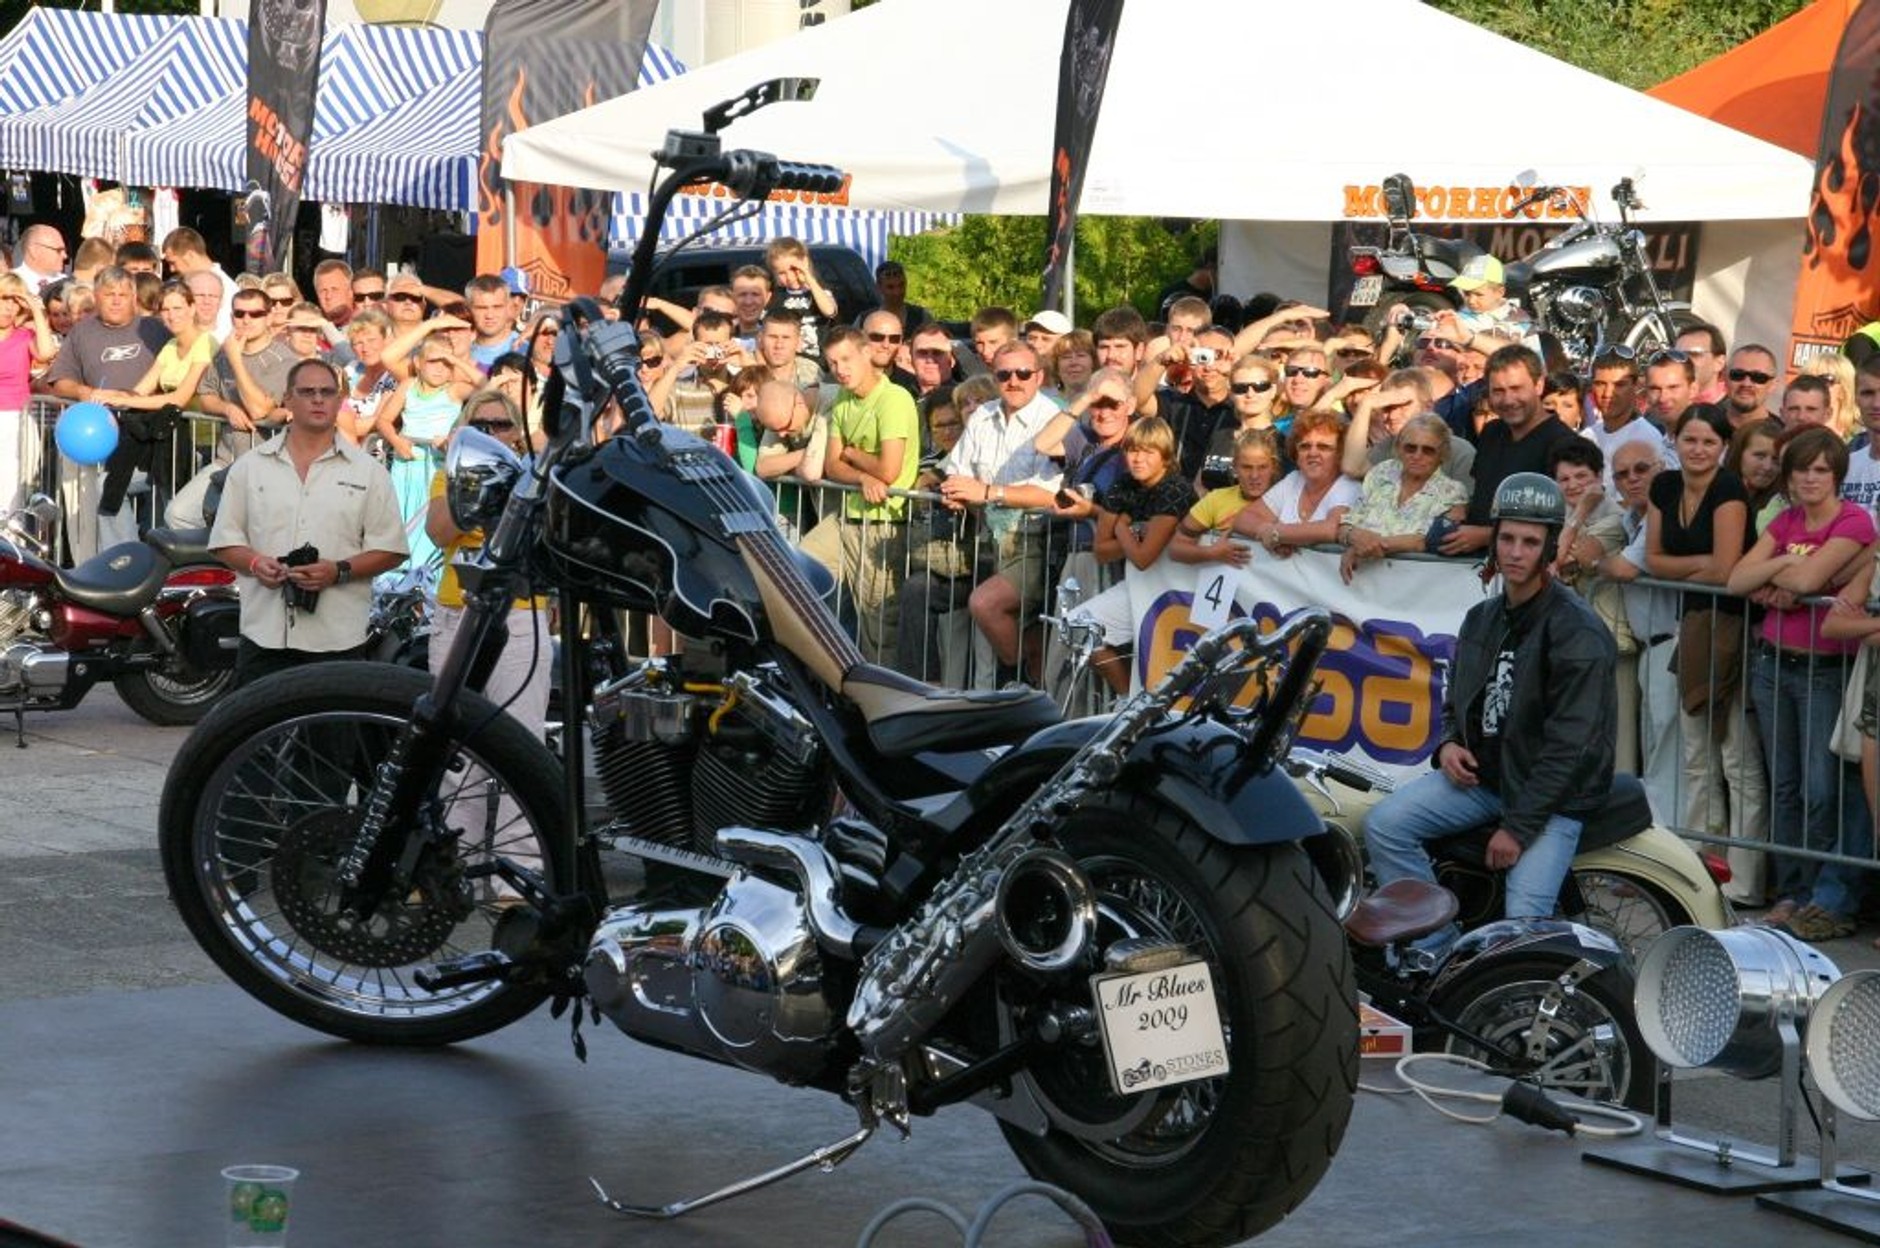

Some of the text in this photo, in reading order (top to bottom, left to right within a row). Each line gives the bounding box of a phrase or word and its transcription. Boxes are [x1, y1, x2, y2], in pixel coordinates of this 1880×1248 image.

[1343, 185, 1591, 218] MORHOUSE
[1204, 574, 1225, 611] 4
[1105, 974, 1206, 1010] Mr Blues
[1138, 1004, 1188, 1031] 2009
[1165, 1049, 1224, 1070] STONES
